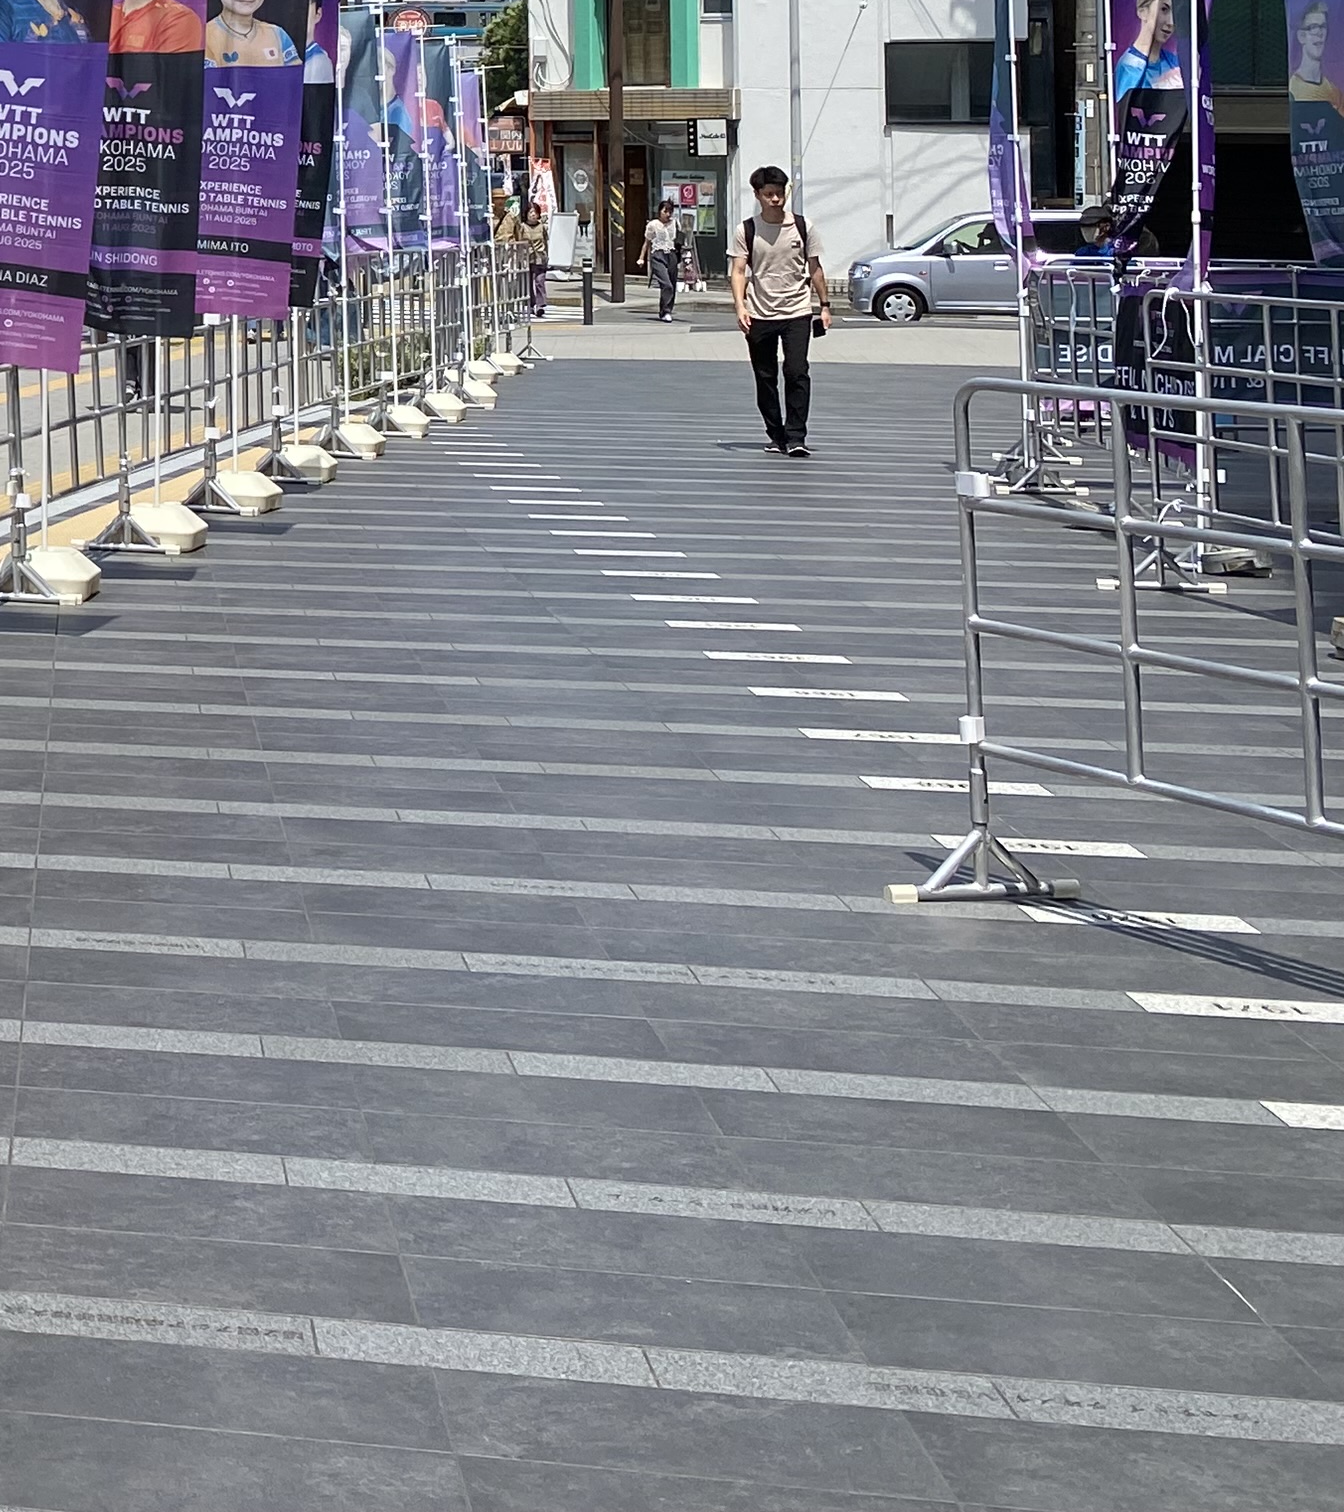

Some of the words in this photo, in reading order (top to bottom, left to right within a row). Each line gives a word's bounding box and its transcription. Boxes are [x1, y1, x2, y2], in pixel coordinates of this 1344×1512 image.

[102, 107, 151, 124] WTT
[211, 113, 255, 129] WTT
[1126, 131, 1167, 147] WTT
[102, 156, 147, 173] 2025
[208, 156, 250, 172] 2025
[105, 198, 142, 210] TABLE
[144, 200, 190, 214] TENNIS
[209, 192, 245, 205] TABLE
[246, 196, 288, 210] TENNIS
[30, 212, 82, 229] TENNIS
[15, 224, 56, 239] BUNTAI
[14, 237, 42, 250] 2025
[196, 239, 229, 251] MIMA
[230, 240, 250, 253] ITO
[105, 253, 158, 267] SHIDONG
[15, 271, 49, 287] DIAZ
